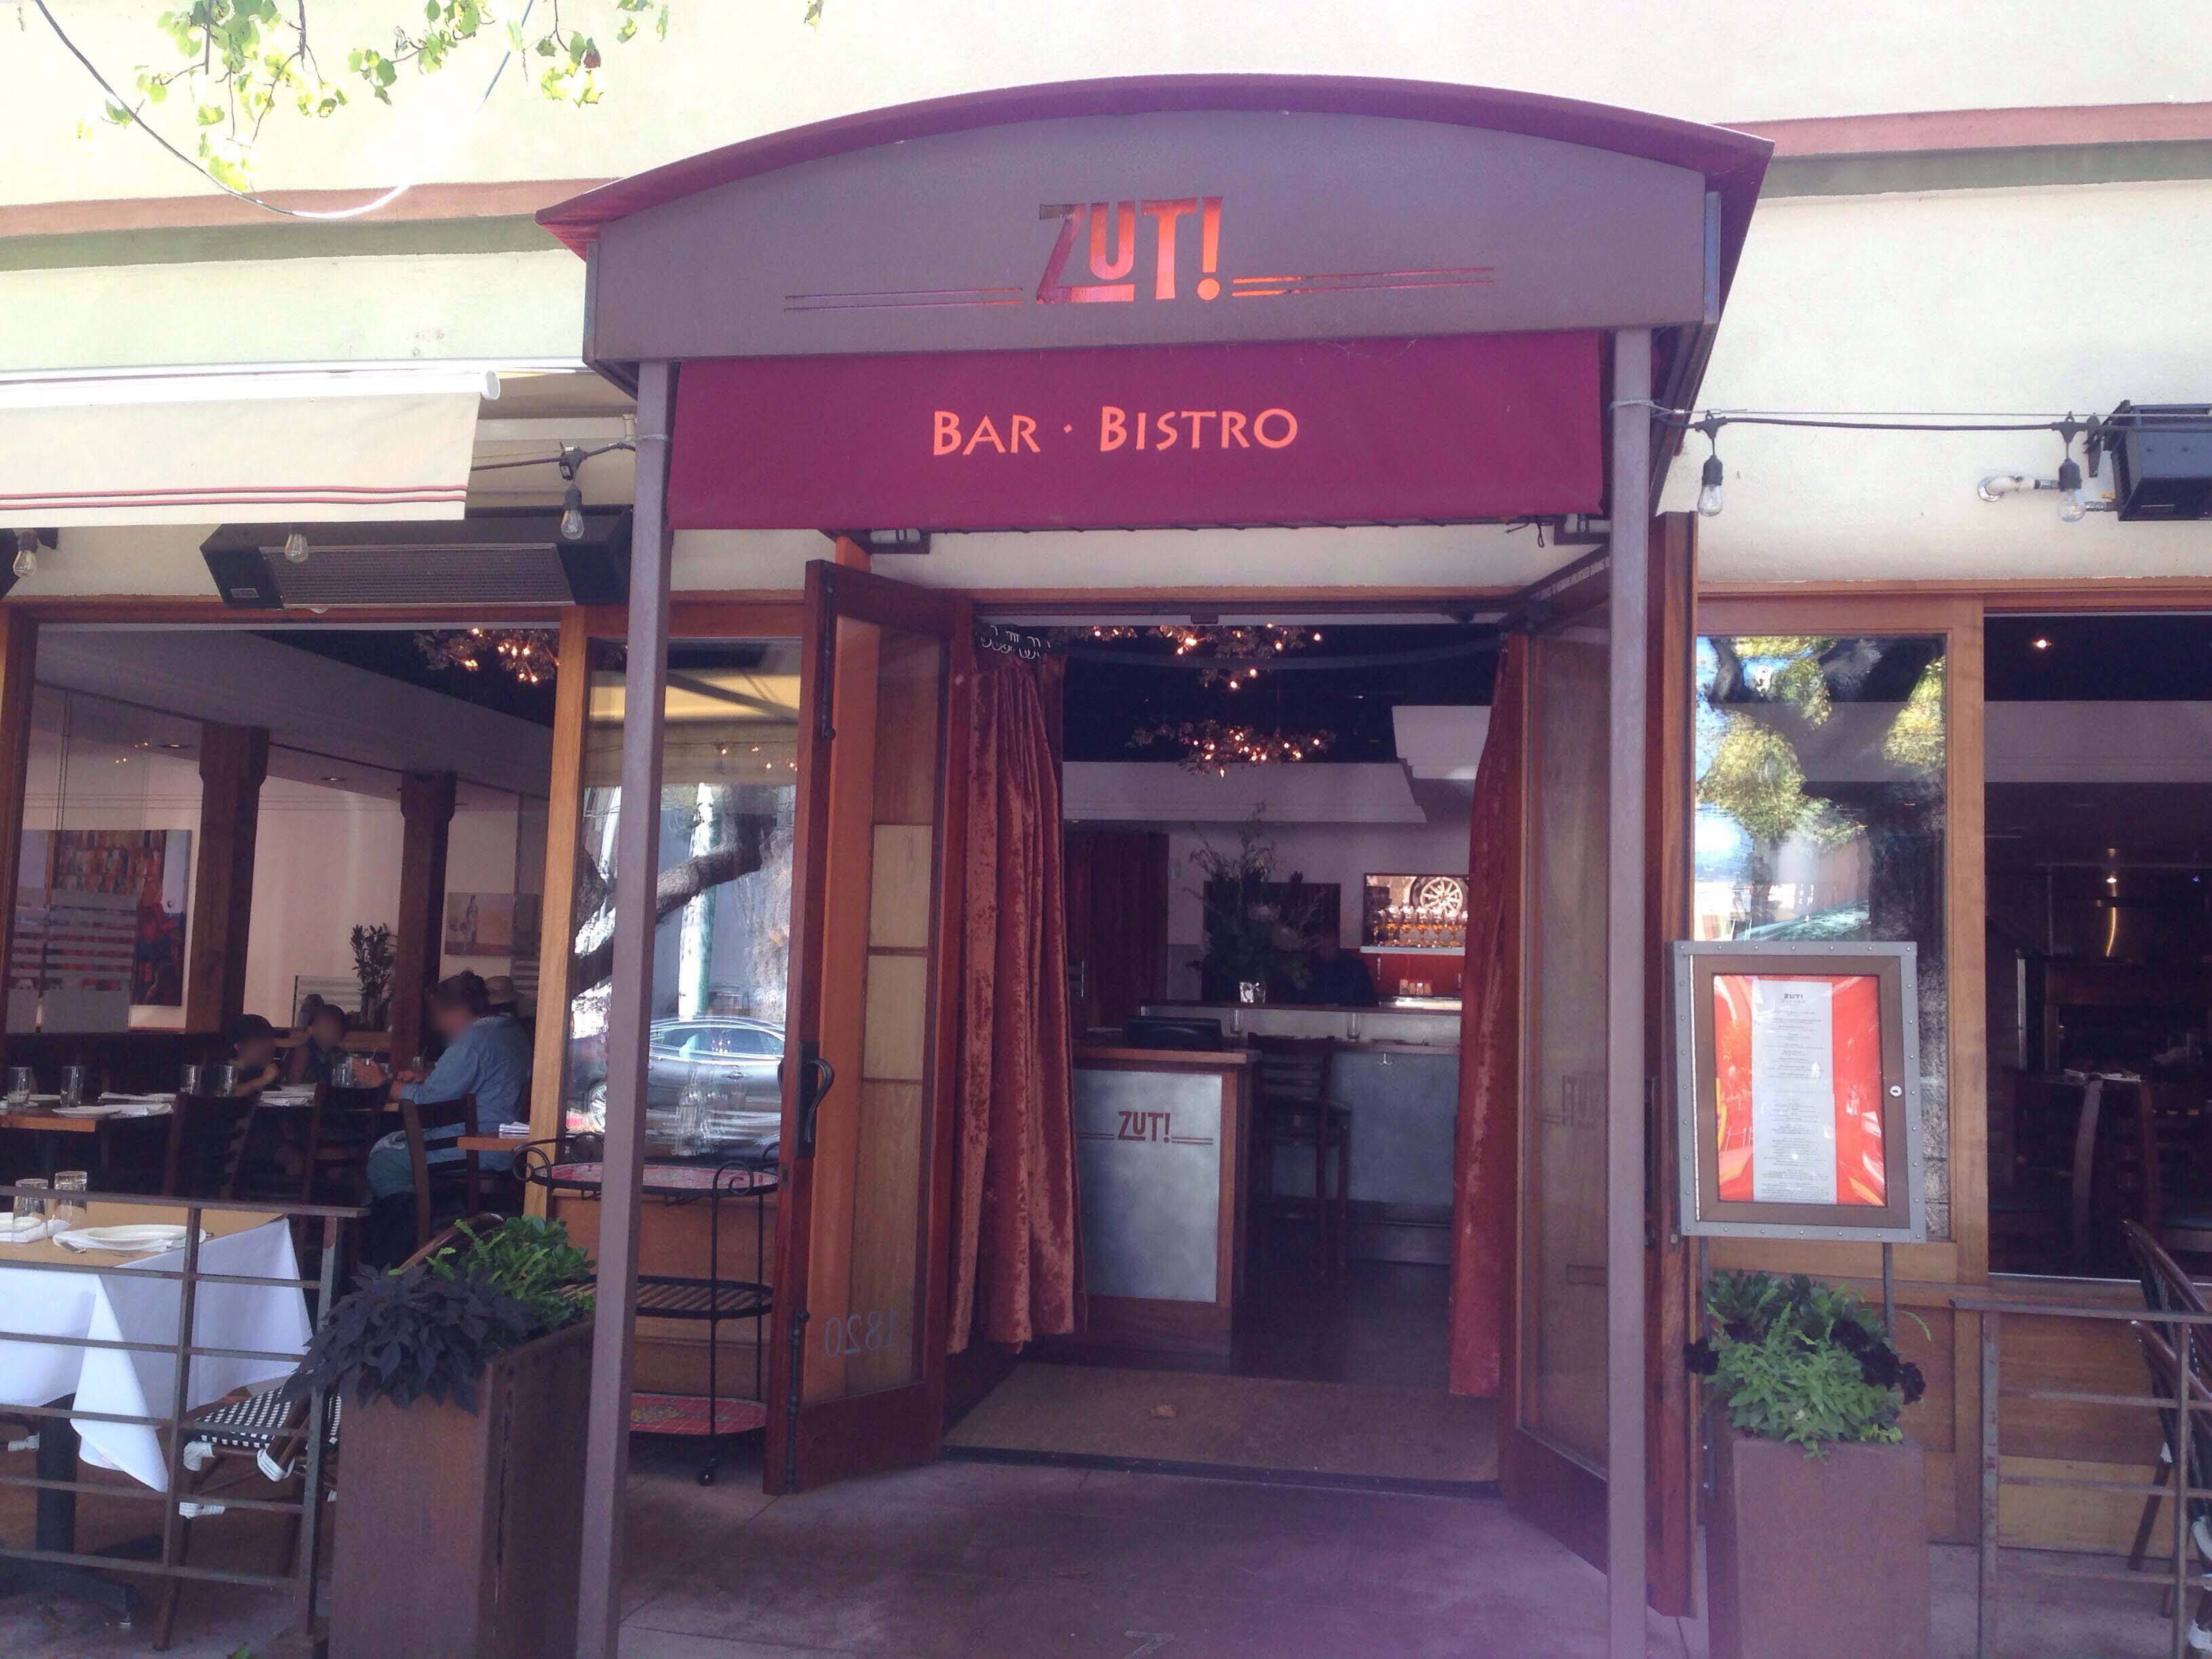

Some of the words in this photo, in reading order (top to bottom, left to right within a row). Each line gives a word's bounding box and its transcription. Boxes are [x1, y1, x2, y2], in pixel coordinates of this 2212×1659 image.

[1036, 196, 1223, 304] ZUT!
[933, 410, 1041, 455] BAR
[1101, 406, 1298, 452] BISTRO
[1118, 1111, 1171, 1143] ZUT!
